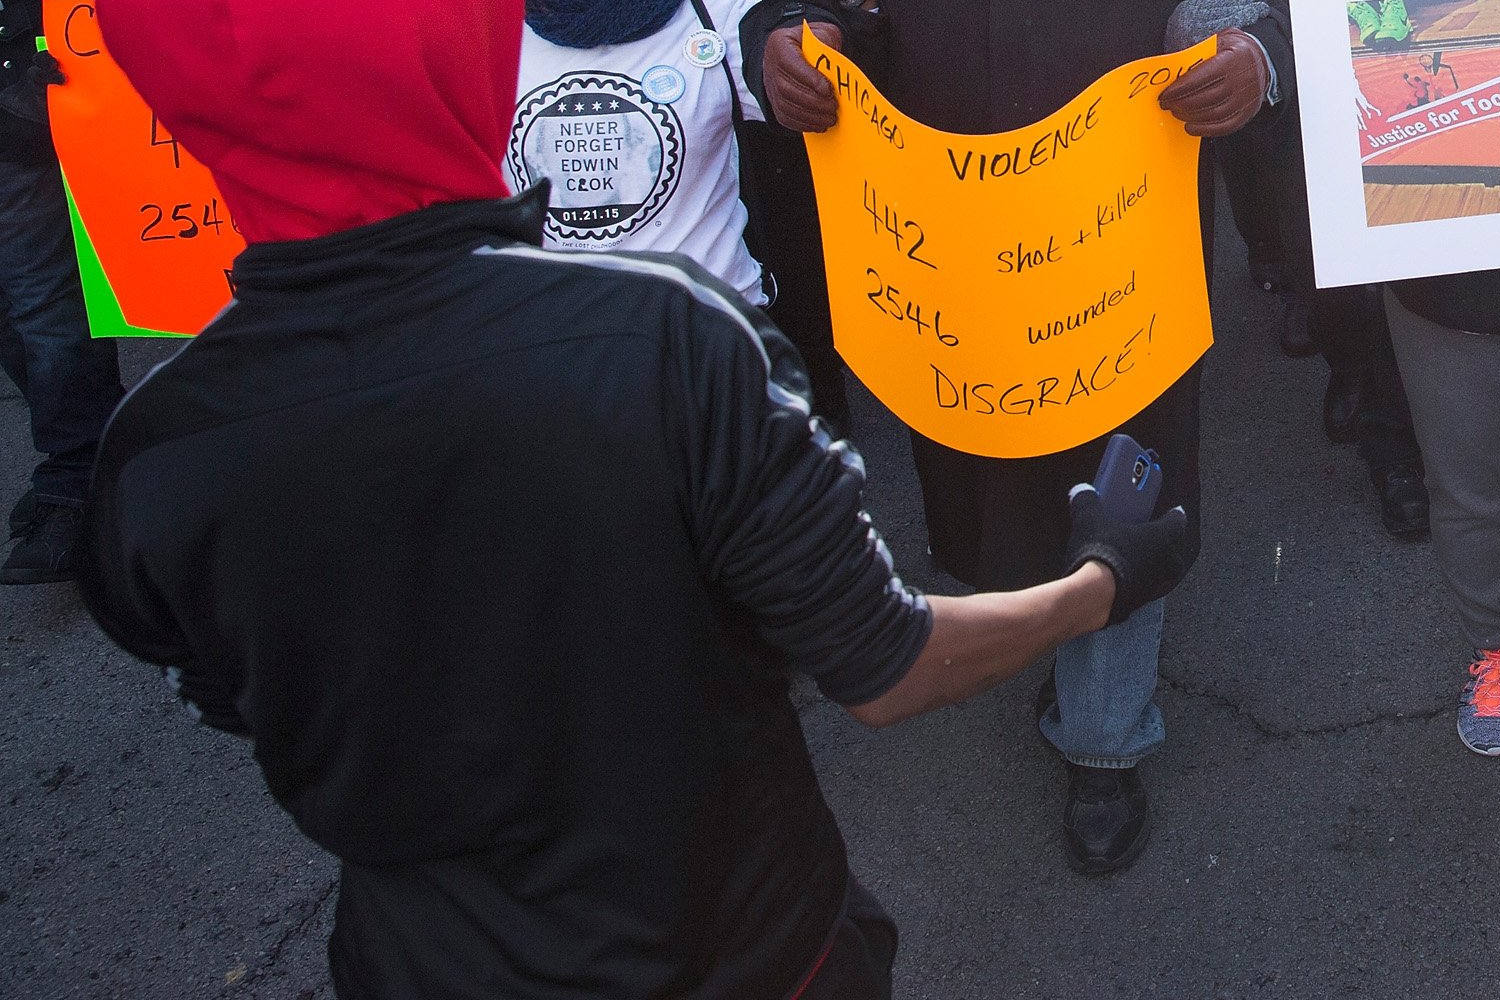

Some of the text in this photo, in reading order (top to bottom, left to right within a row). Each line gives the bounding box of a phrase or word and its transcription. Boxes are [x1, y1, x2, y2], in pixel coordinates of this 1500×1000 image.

[554, 137, 624, 153] FORGET
[559, 121, 619, 137] NEVER
[947, 96, 1102, 181] VIOLENCE
[1366, 119, 1427, 149] Justice
[1428, 106, 1460, 130] for
[561, 156, 619, 172] EDWIN
[562, 208, 619, 222] 01.21.15
[863, 179, 938, 270] 442
[996, 235, 1062, 274] shot
[866, 268, 1136, 347] 2546 wounded
[930, 313, 1157, 415] DISGRACE!
